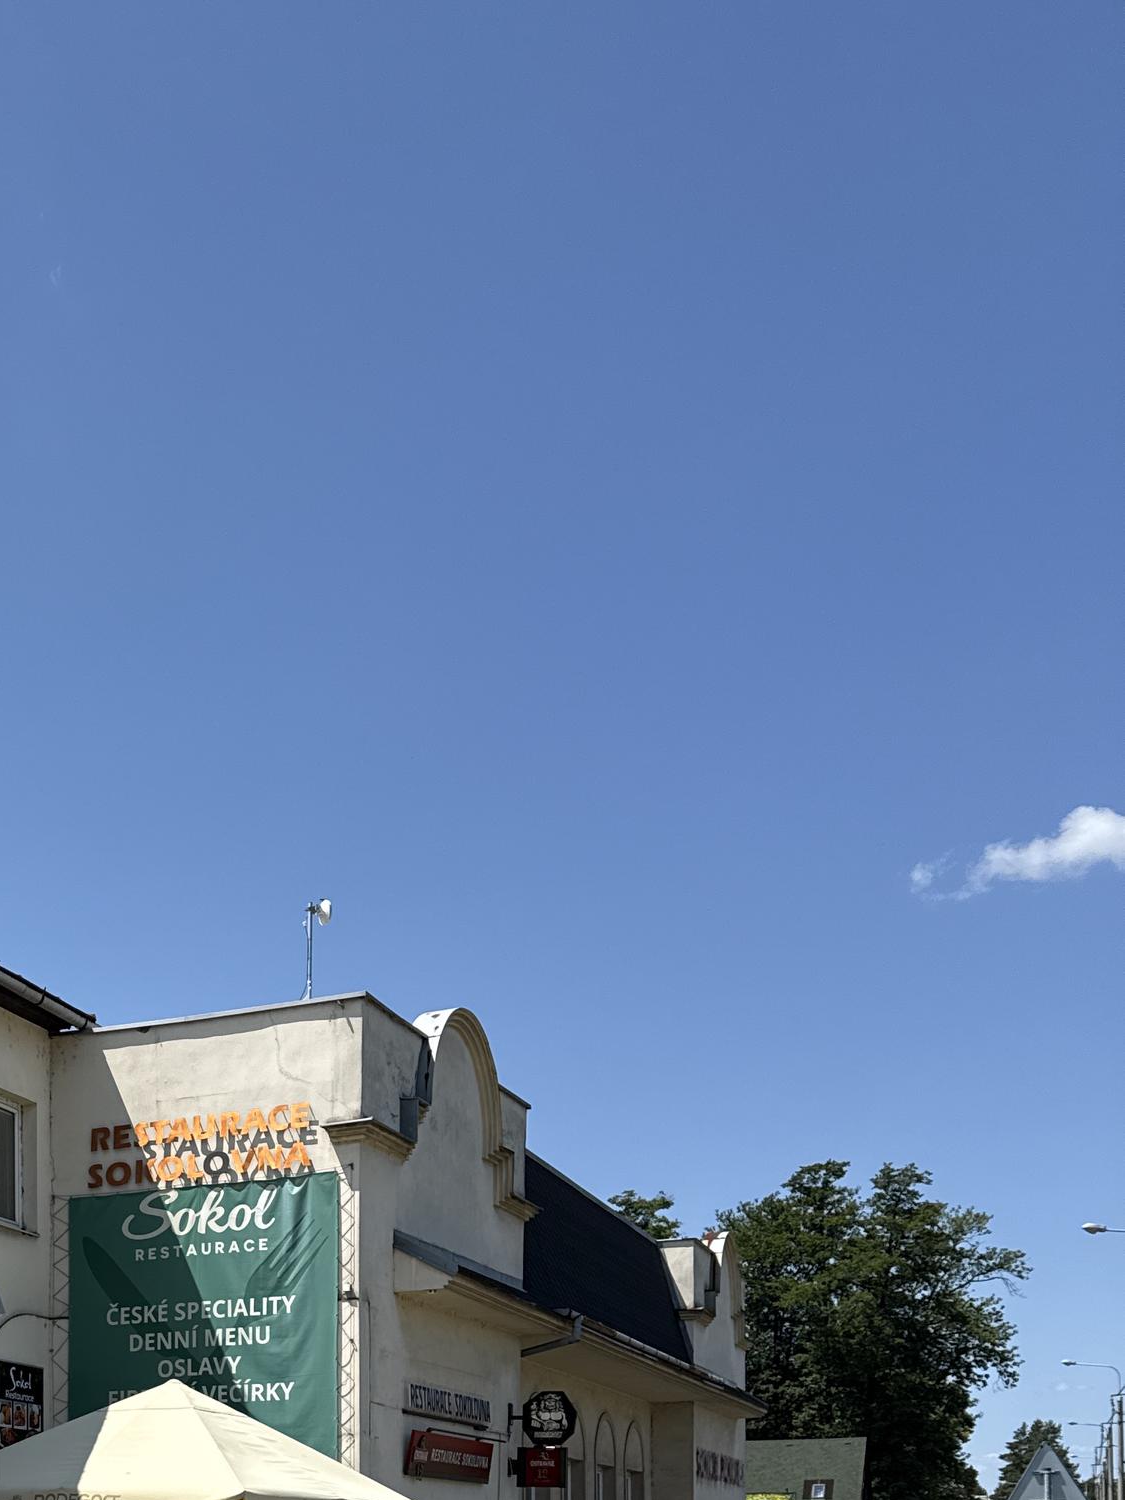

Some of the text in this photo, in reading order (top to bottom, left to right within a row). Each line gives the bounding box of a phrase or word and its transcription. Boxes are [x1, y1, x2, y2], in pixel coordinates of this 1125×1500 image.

[90, 1102, 311, 1152] RESTAURACE
[87, 1141, 312, 1189] SOKOLOVNA
[121, 1185, 276, 1241] Sokol
[135, 1238, 269, 1262] RESTAURACE
[106, 1294, 296, 1327] ČESKÉ SPECIALITY
[129, 1323, 271, 1353] DENNÍ MENU
[157, 1355, 242, 1378] OSLAVY
[202, 1378, 295, 1403] VEČÍRKY
[410, 1383, 452, 1415] RESTAURACE
